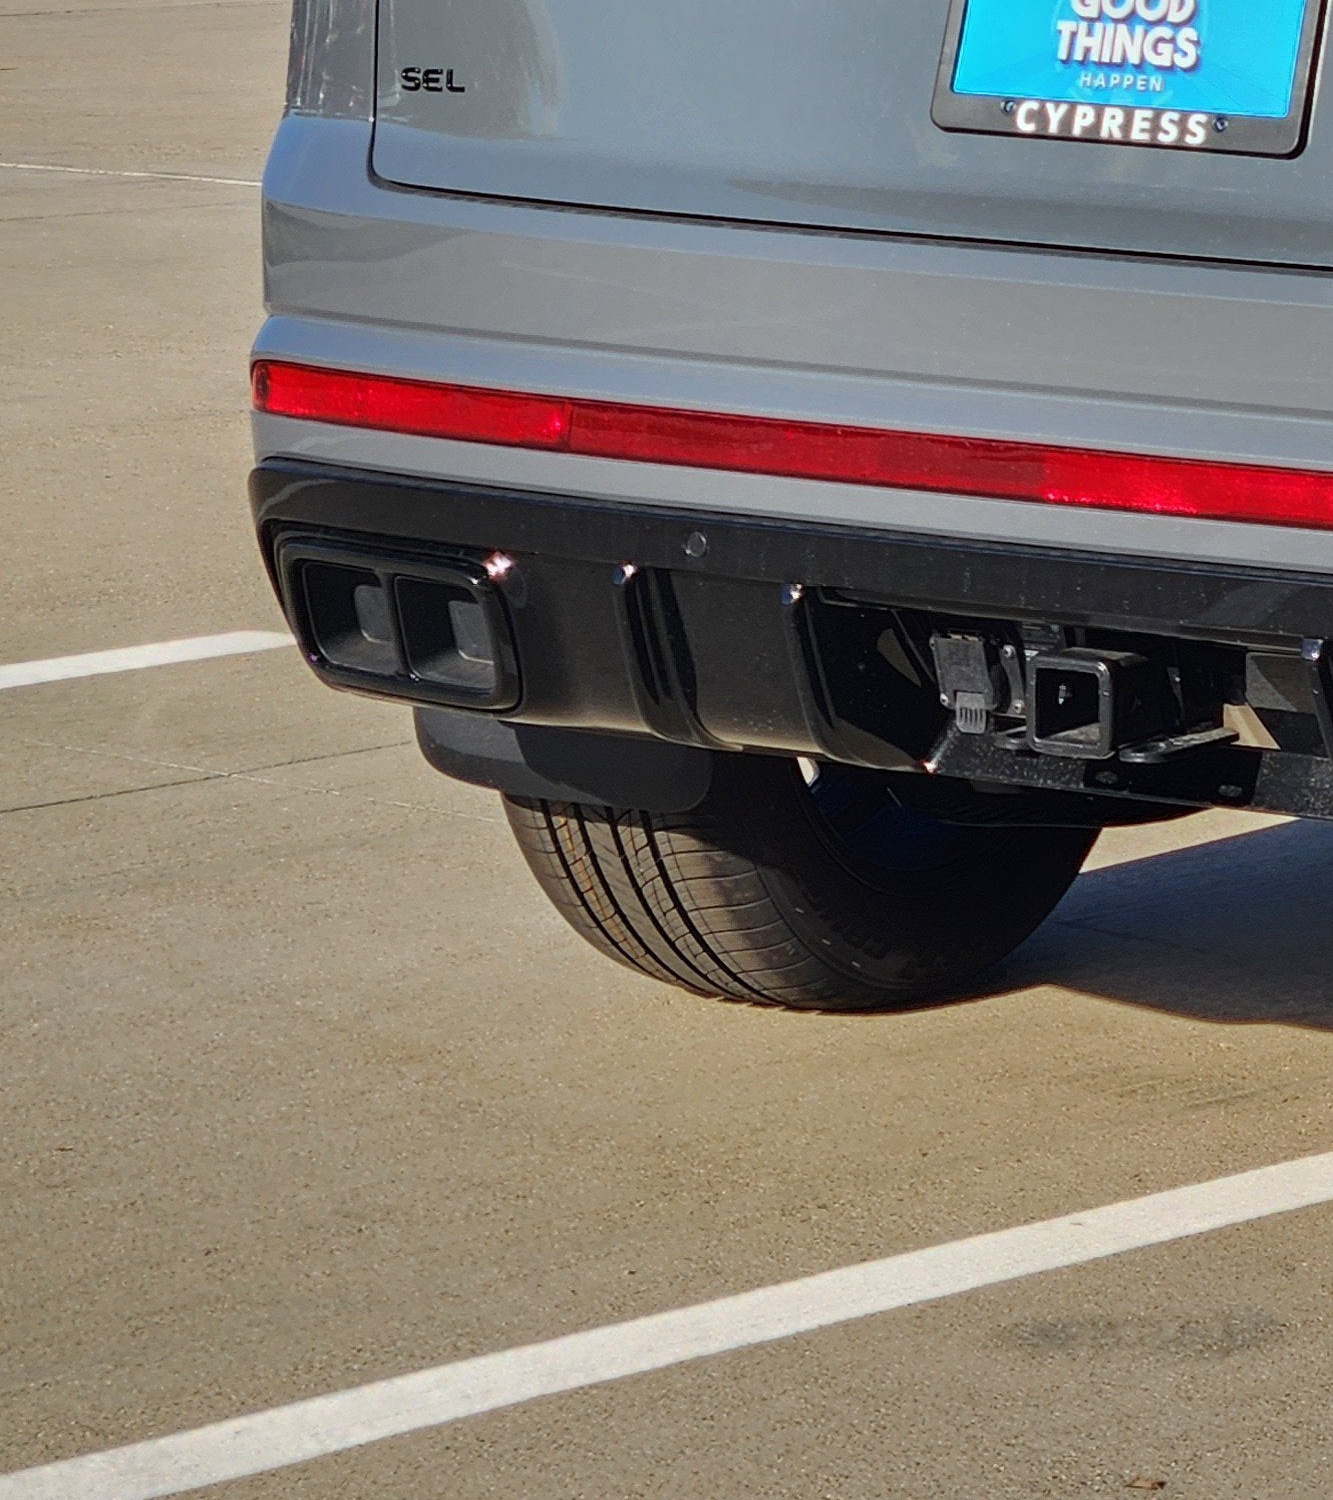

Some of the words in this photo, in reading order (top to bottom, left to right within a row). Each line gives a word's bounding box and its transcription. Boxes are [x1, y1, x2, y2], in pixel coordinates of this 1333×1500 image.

[1056, 20, 1201, 70] THINGS
[401, 66, 465, 92] SEL
[1078, 73, 1165, 93] HAPPEN
[1015, 100, 1210, 145] CYPRESS
